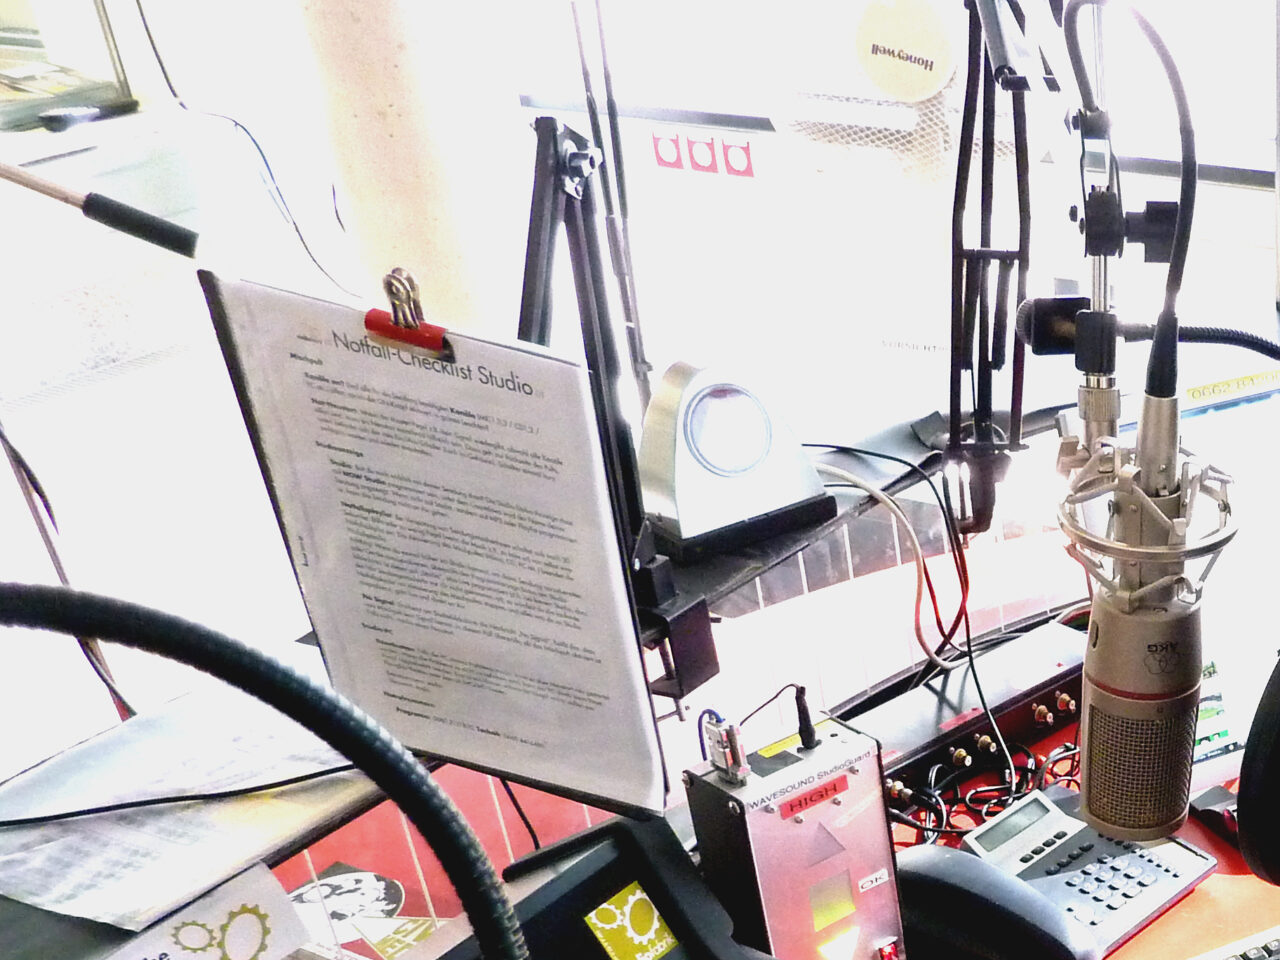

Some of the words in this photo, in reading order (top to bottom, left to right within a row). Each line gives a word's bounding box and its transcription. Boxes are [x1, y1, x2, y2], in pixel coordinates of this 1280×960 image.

[871, 43, 934, 72] Honeywell
[477, 365, 534, 396] Studio
[1147, 642, 1179, 654] AKG
[749, 775, 815, 810] WAVESOUND
[817, 750, 872, 779] StudioGuard
[789, 783, 839, 813] HIGH
[860, 873, 886, 890] OK
